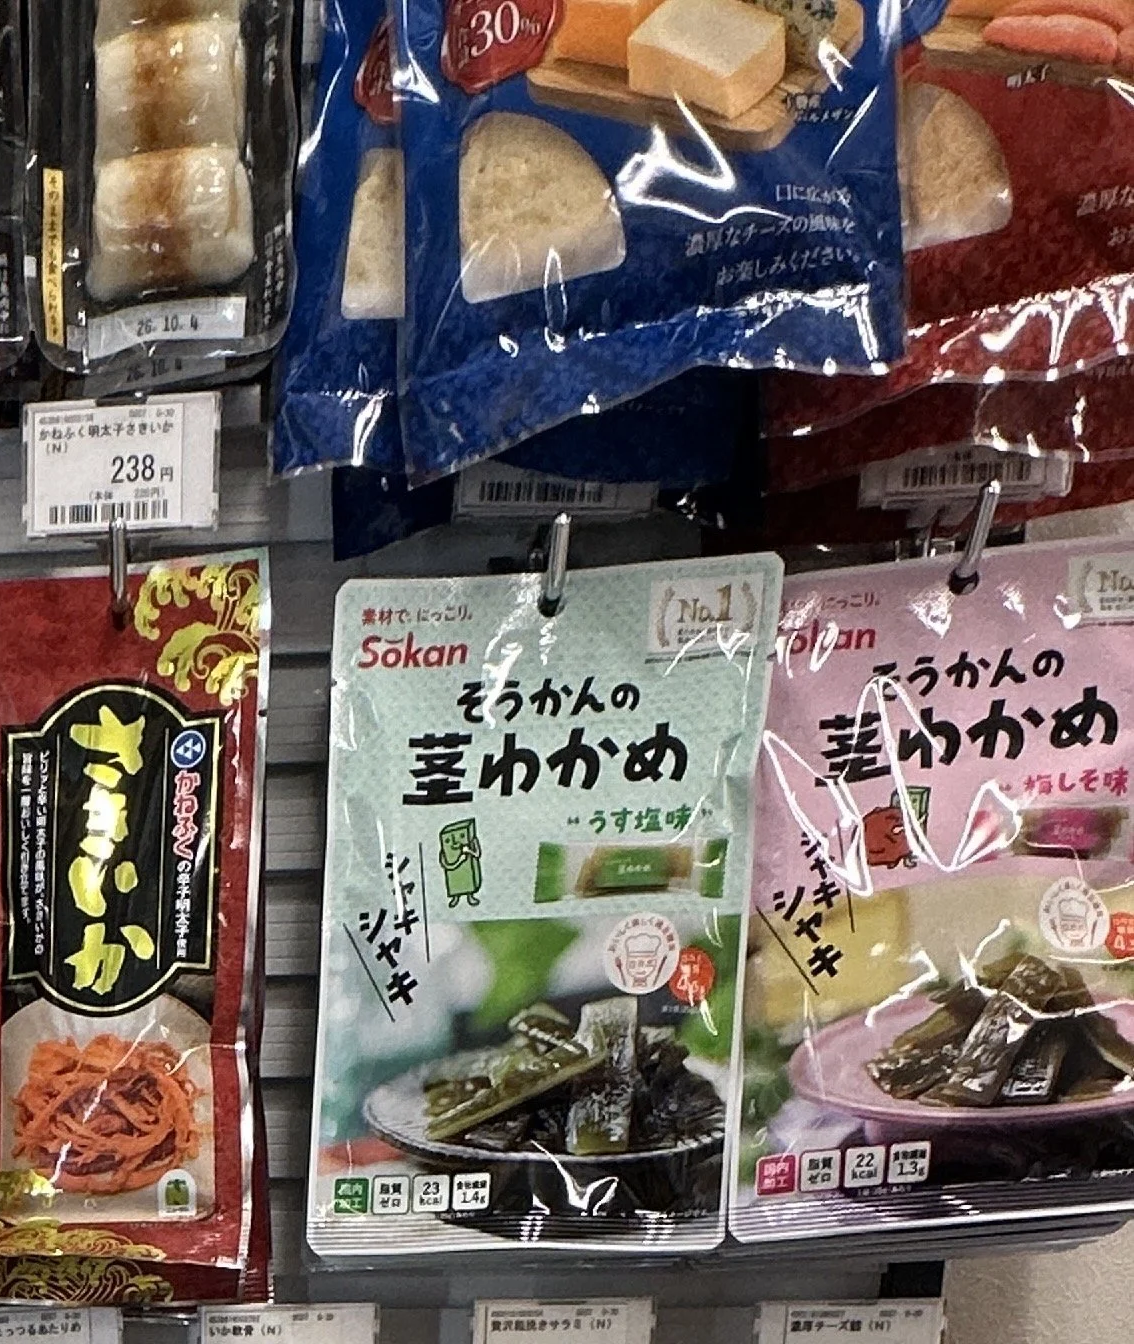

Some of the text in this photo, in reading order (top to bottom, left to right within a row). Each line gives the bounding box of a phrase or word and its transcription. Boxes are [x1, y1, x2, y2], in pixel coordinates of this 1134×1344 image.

[38, 421, 174, 442] かねふく明太子さきいか
[871, 649, 1066, 699] そうかんの
[457, 675, 642, 724] そうかんの
[815, 686, 1120, 788] 茎わかめ
[402, 722, 689, 806] 茎わかめ
[64, 704, 156, 996] さきいか
[359, 908, 419, 1006] シャキ
[772, 887, 843, 978] シャキ
[808, 1156, 834, 1171] 脂質
[808, 1172, 832, 1184] ゼロ
[851, 1166, 878, 1180] kcal
[855, 1152, 875, 1168] 22
[422, 1181, 442, 1196] 23
